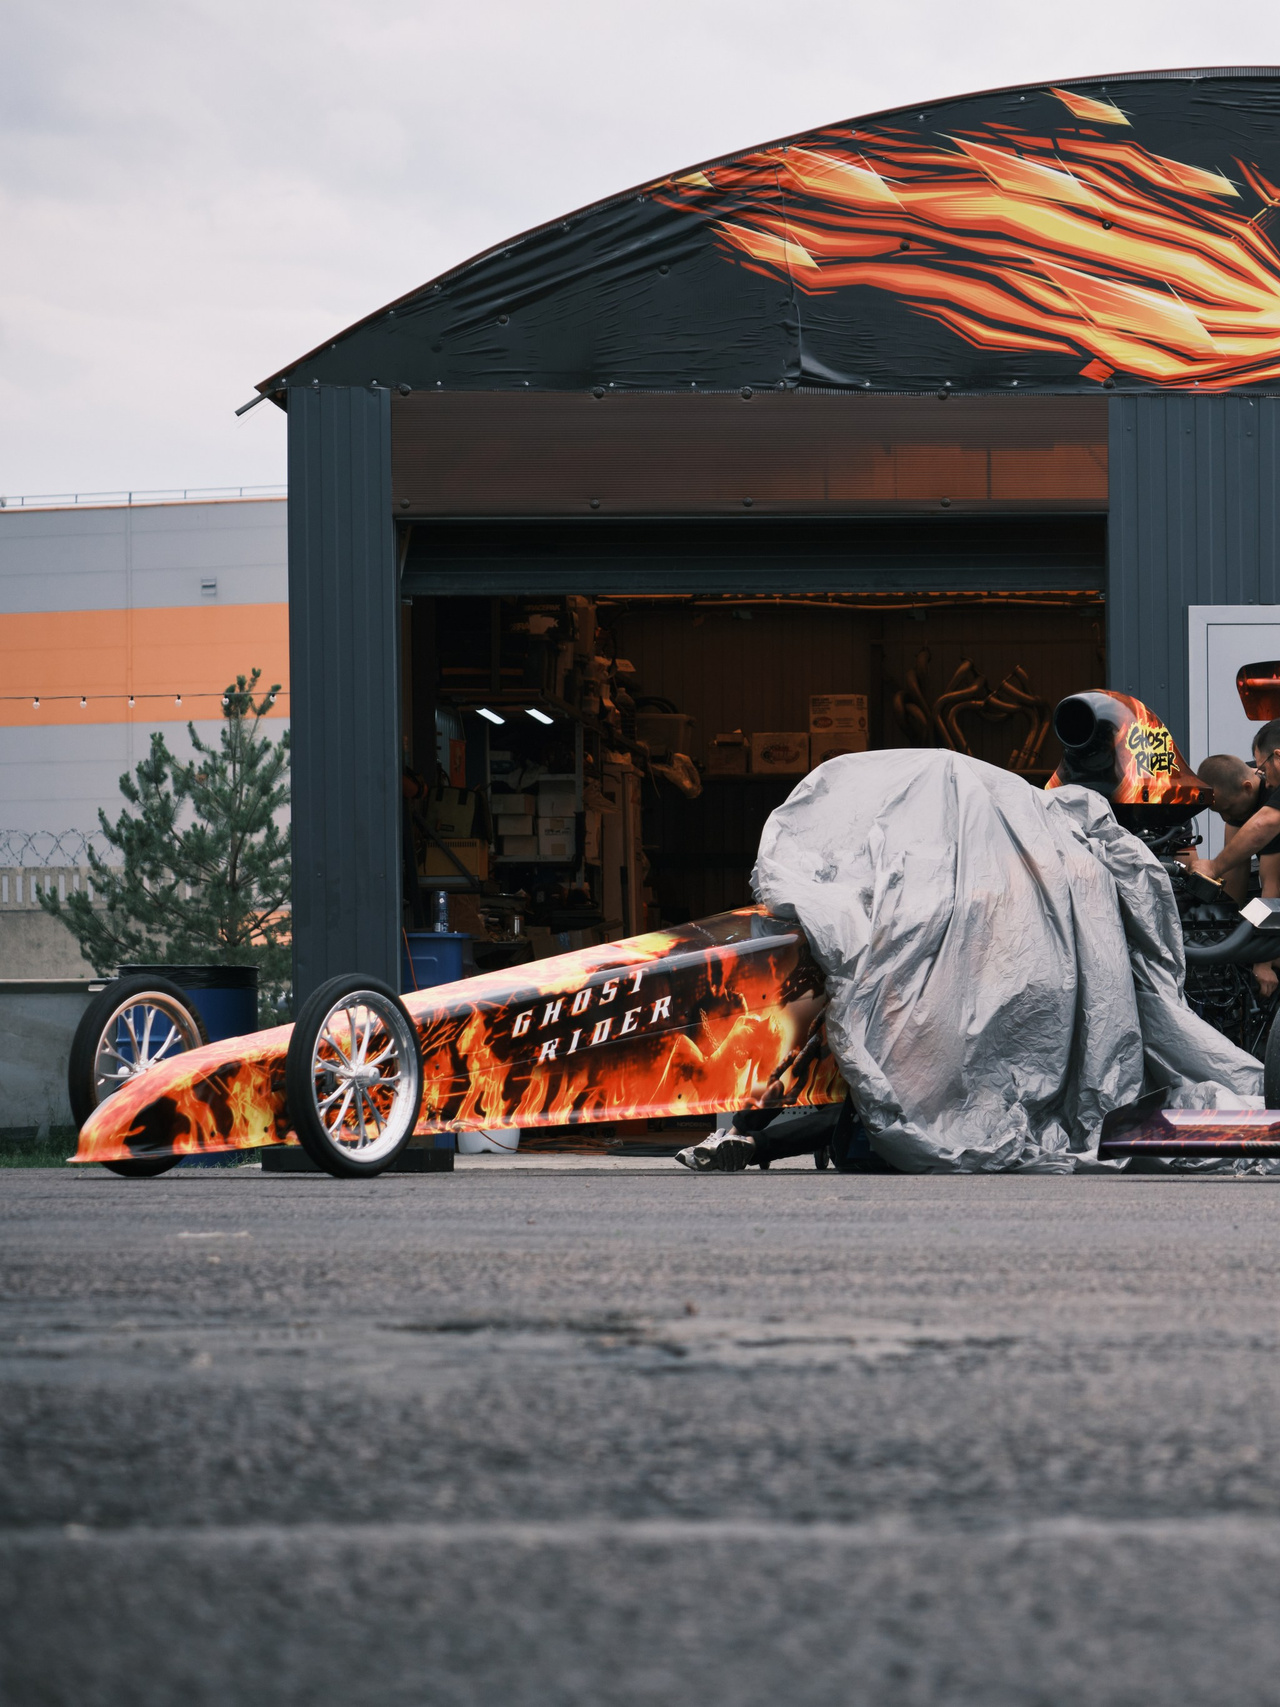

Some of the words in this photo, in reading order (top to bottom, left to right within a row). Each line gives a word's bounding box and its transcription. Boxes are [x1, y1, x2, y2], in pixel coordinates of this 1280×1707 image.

[1128, 726, 1169, 752] GHOST
[1135, 751, 1180, 777] RIDER
[511, 967, 649, 1039] GHOST
[535, 995, 672, 1065] RIDER
